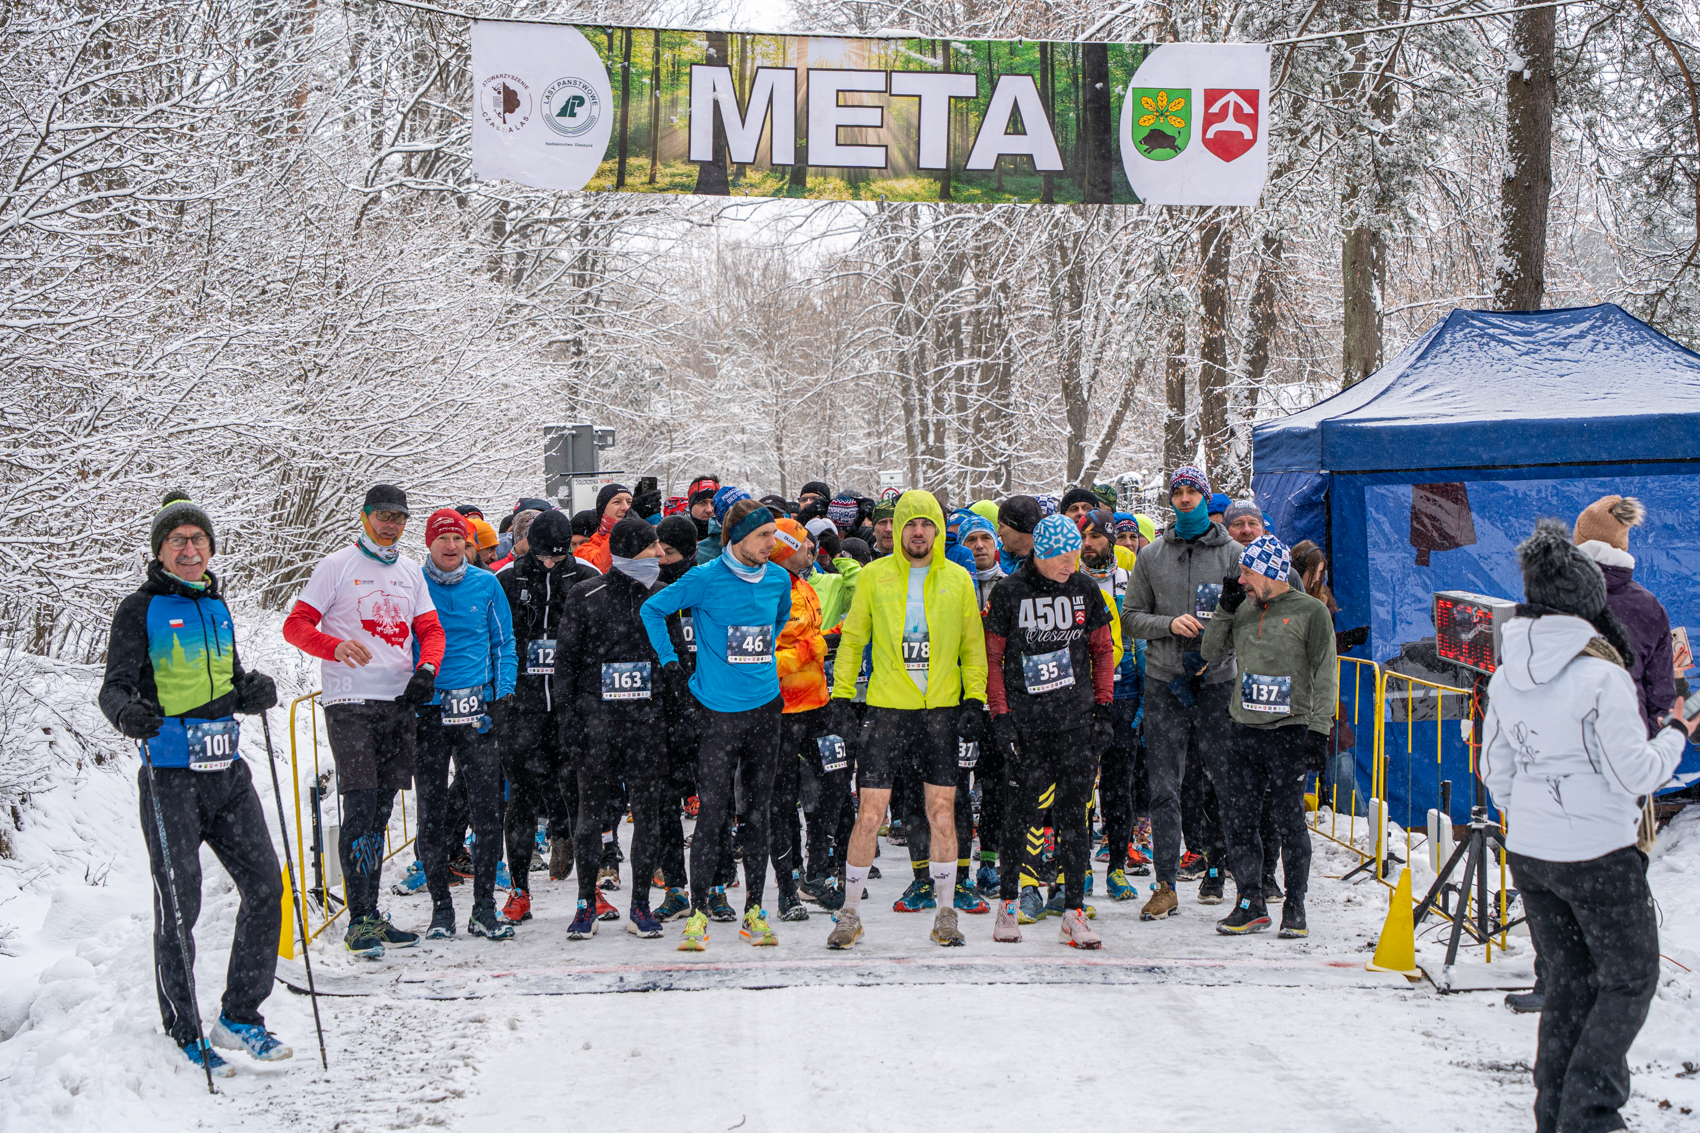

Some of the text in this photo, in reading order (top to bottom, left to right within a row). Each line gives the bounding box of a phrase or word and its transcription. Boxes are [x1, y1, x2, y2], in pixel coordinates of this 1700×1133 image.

[482, 73, 530, 91] STOWARZYSZENIE
[543, 85, 556, 105] LASY
[515, 115, 530, 131] LAS
[689, 63, 1064, 172] META
[1072, 595, 1084, 605] LAT
[1018, 596, 1073, 630] 450
[742, 635, 764, 652] 46
[902, 641, 930, 658] 178
[612, 671, 642, 689] 163
[1037, 662, 1058, 681] 35
[1251, 684, 1279, 701] 137
[450, 696, 479, 714] 169
[203, 733, 230, 757] 101
